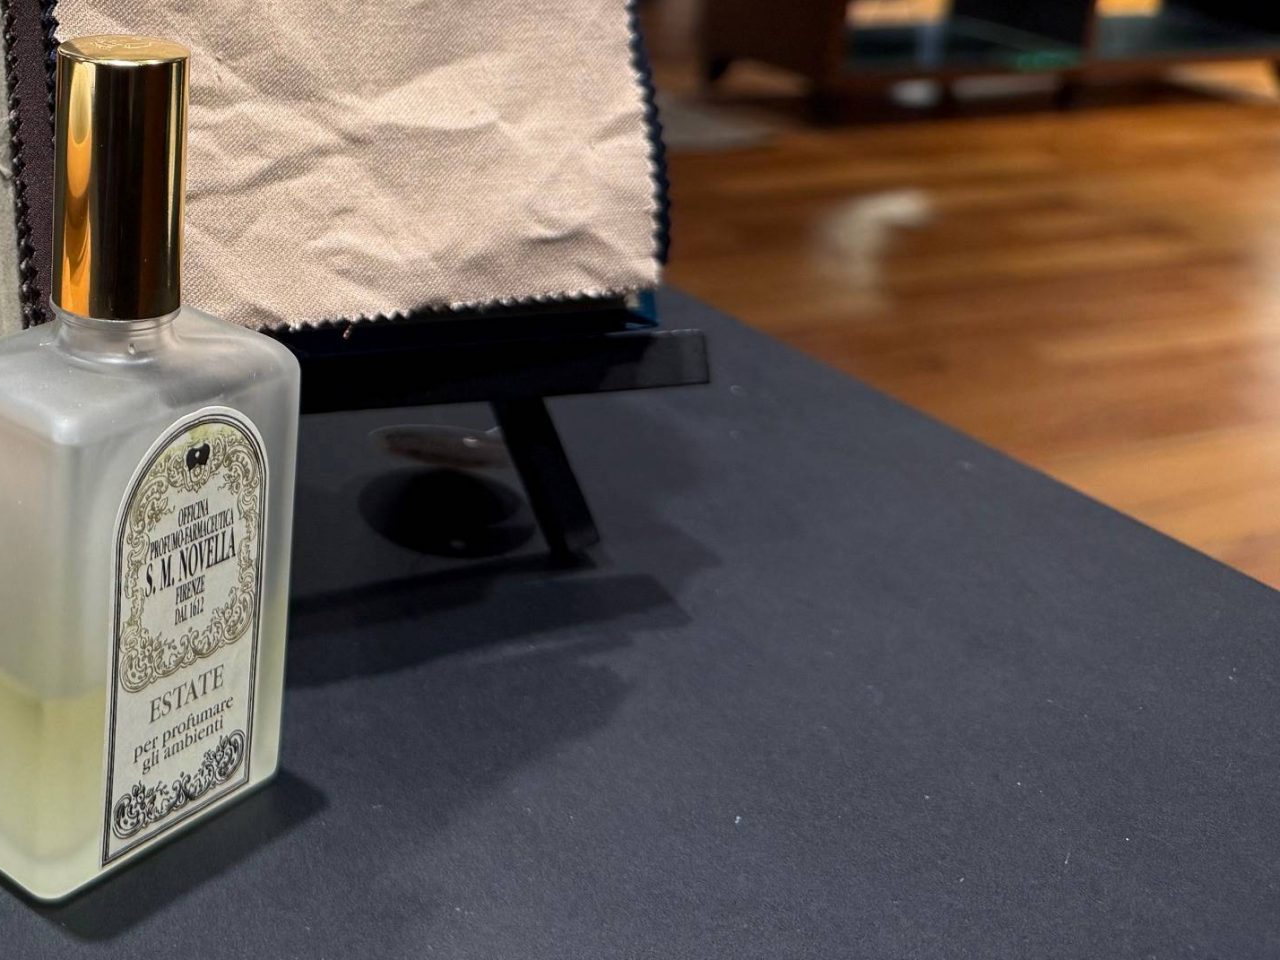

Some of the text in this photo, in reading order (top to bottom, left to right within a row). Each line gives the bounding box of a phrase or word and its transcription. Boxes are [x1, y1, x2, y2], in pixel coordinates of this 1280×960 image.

[150, 508, 234, 561] PROFUMO-FARMACEUTICA
[178, 498, 209, 527] OFFICINA
[145, 527, 236, 597] S. M. NOVELLA
[175, 574, 205, 605] FIRENZE
[175, 596, 204, 626] DAL 1612
[149, 664, 224, 724] ESTATE
[133, 696, 233, 764] per profumare
[142, 715, 223, 775] gli ambienti
